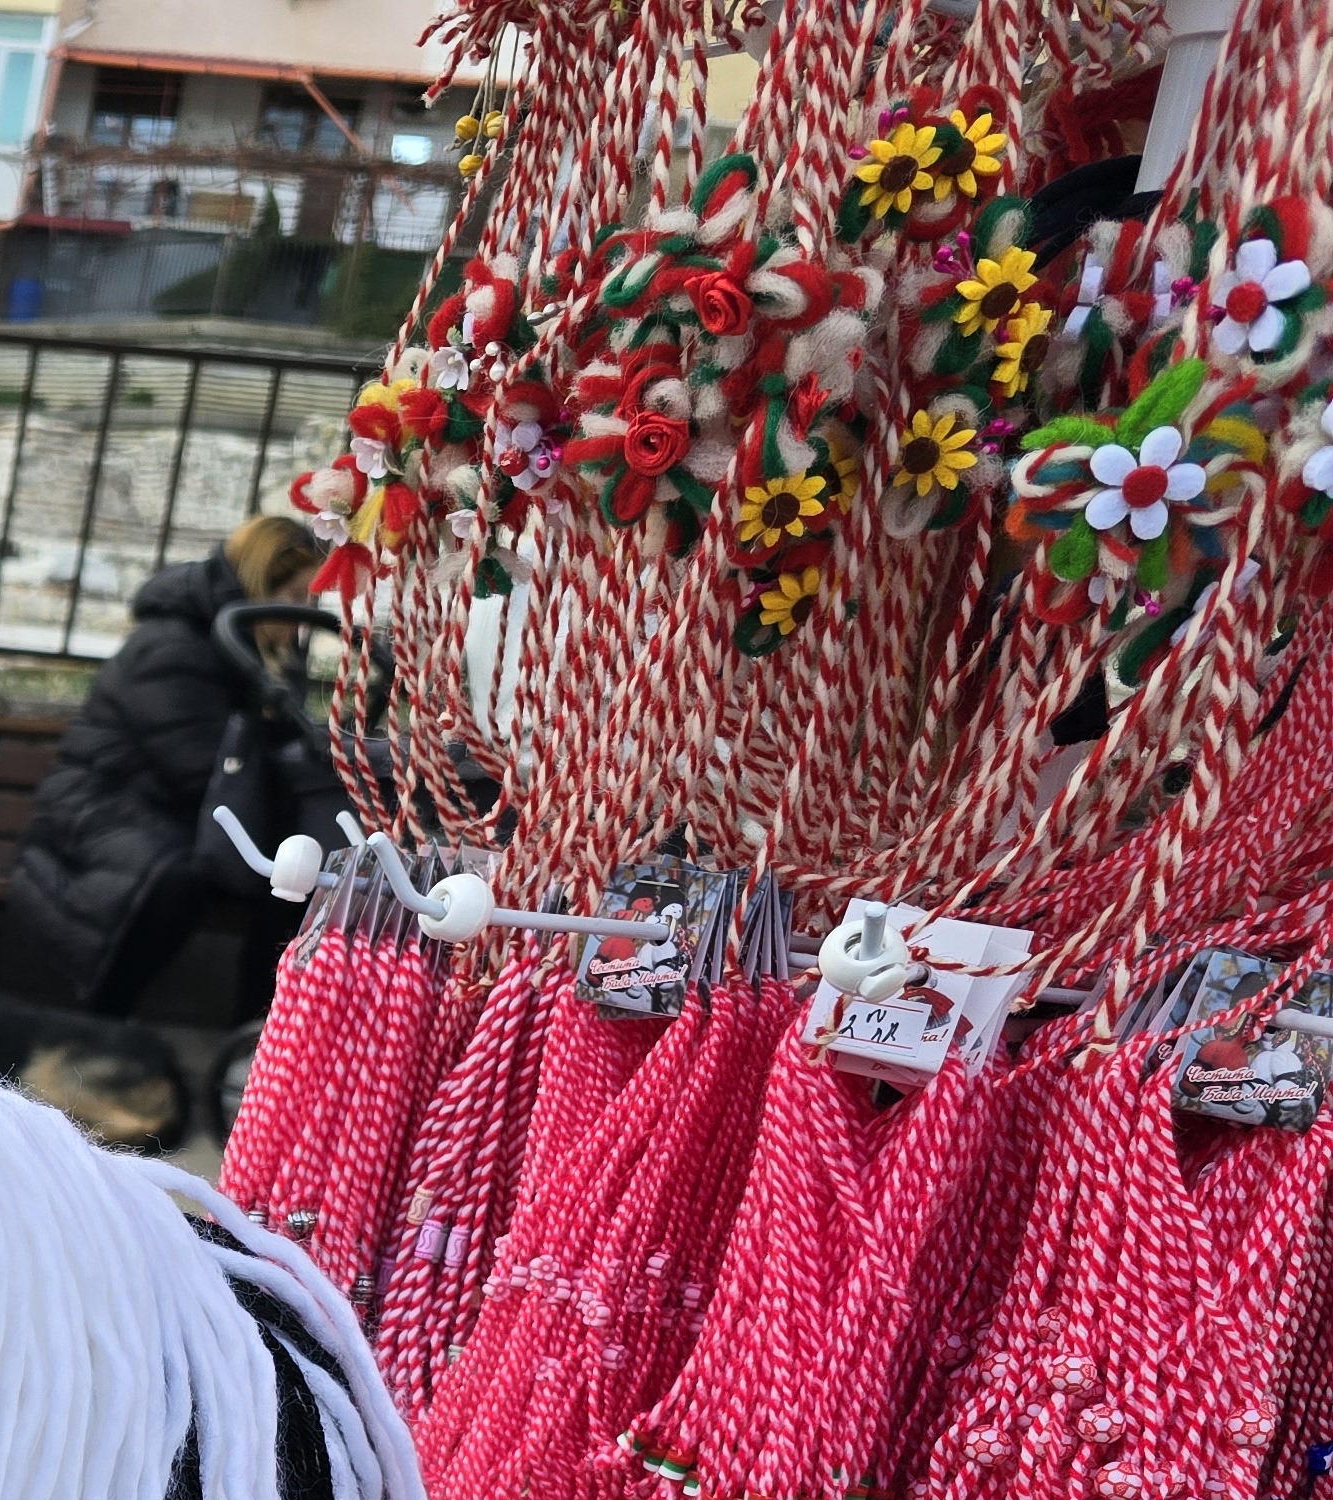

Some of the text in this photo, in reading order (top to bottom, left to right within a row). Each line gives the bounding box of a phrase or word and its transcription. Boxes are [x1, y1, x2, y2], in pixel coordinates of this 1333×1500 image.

[590, 958, 641, 975] Честита
[603, 966, 688, 991] Баба Марта!
[1187, 1066, 1256, 1082] Честита
[1202, 1082, 1318, 1104] Баба Марта!
